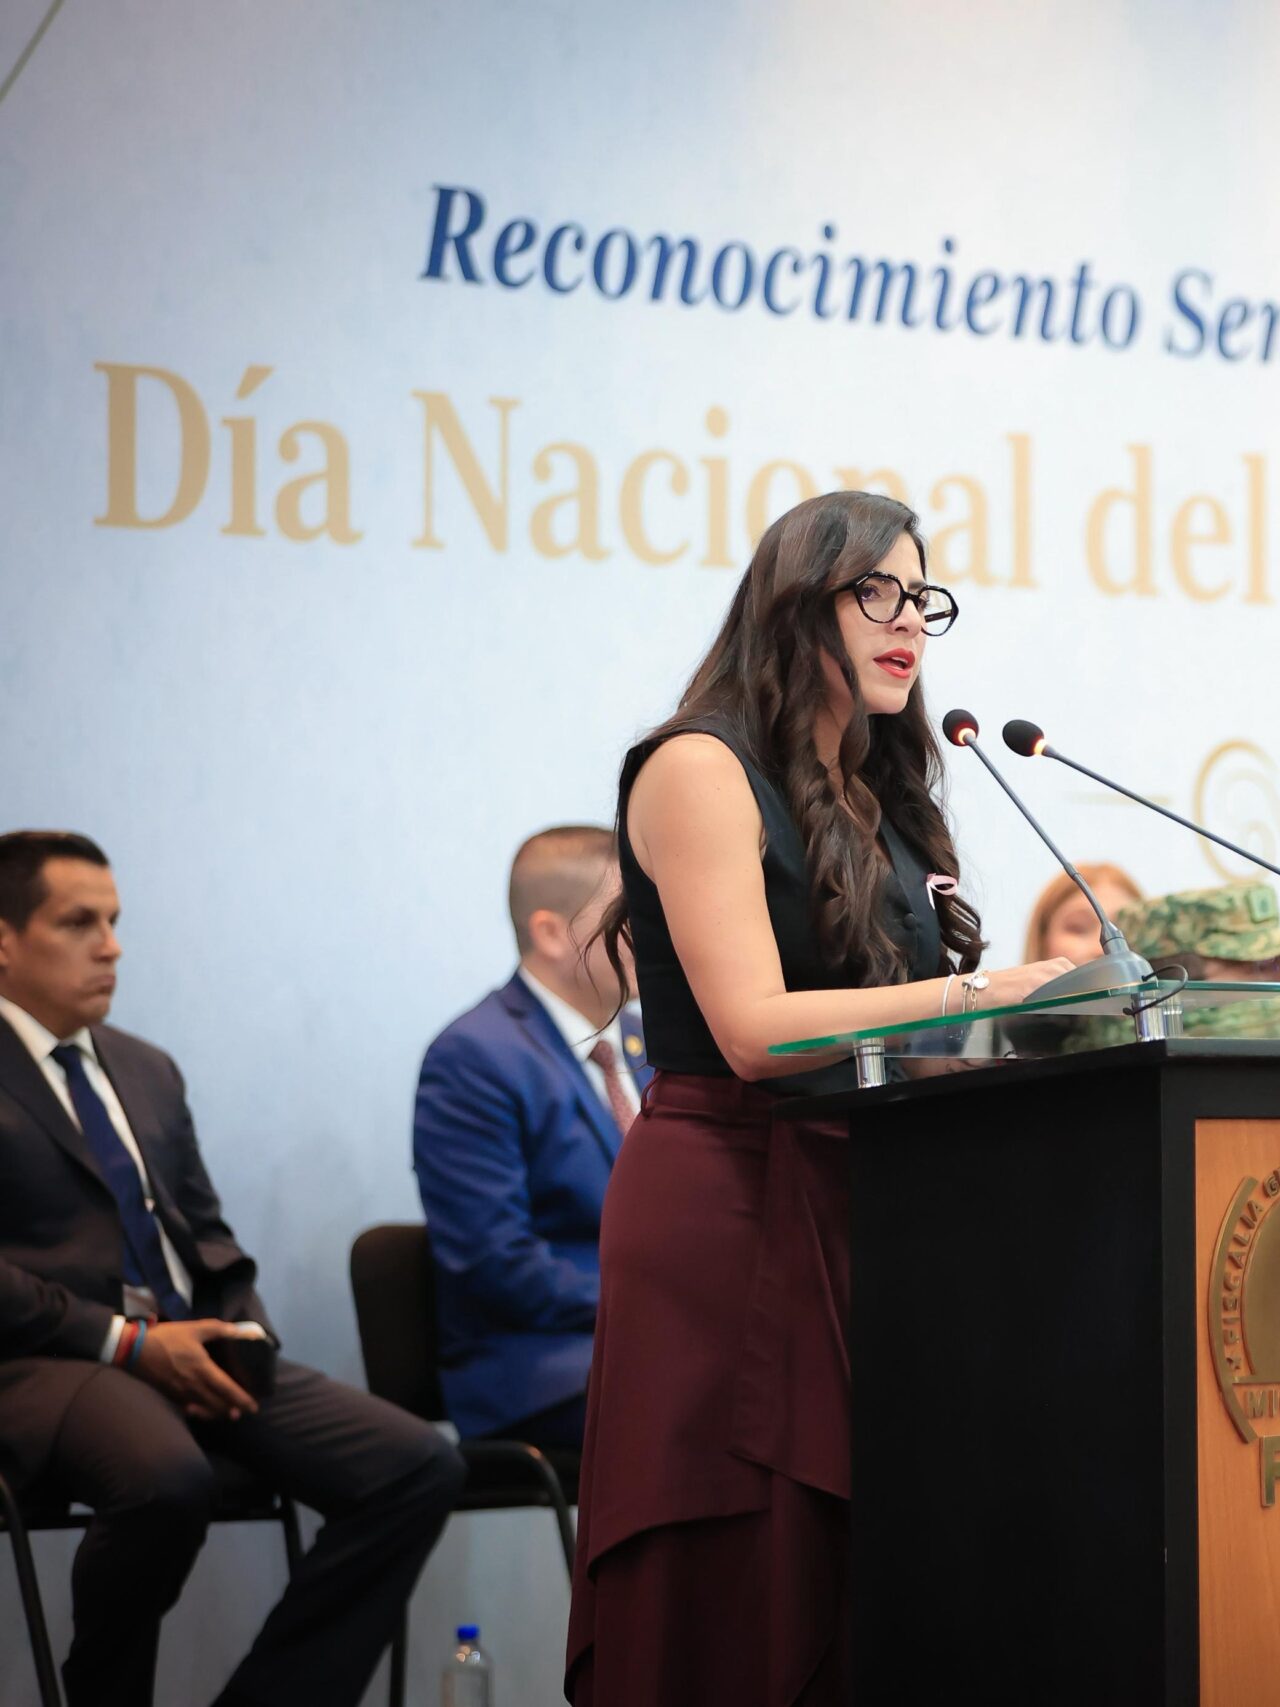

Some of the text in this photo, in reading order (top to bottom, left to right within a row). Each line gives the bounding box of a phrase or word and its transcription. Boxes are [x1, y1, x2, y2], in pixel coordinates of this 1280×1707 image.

[419, 183, 1141, 350] Reconocimiento
[93, 362, 363, 546] Día
[411, 388, 1040, 590] Nacioal
[1085, 443, 1272, 607] del
